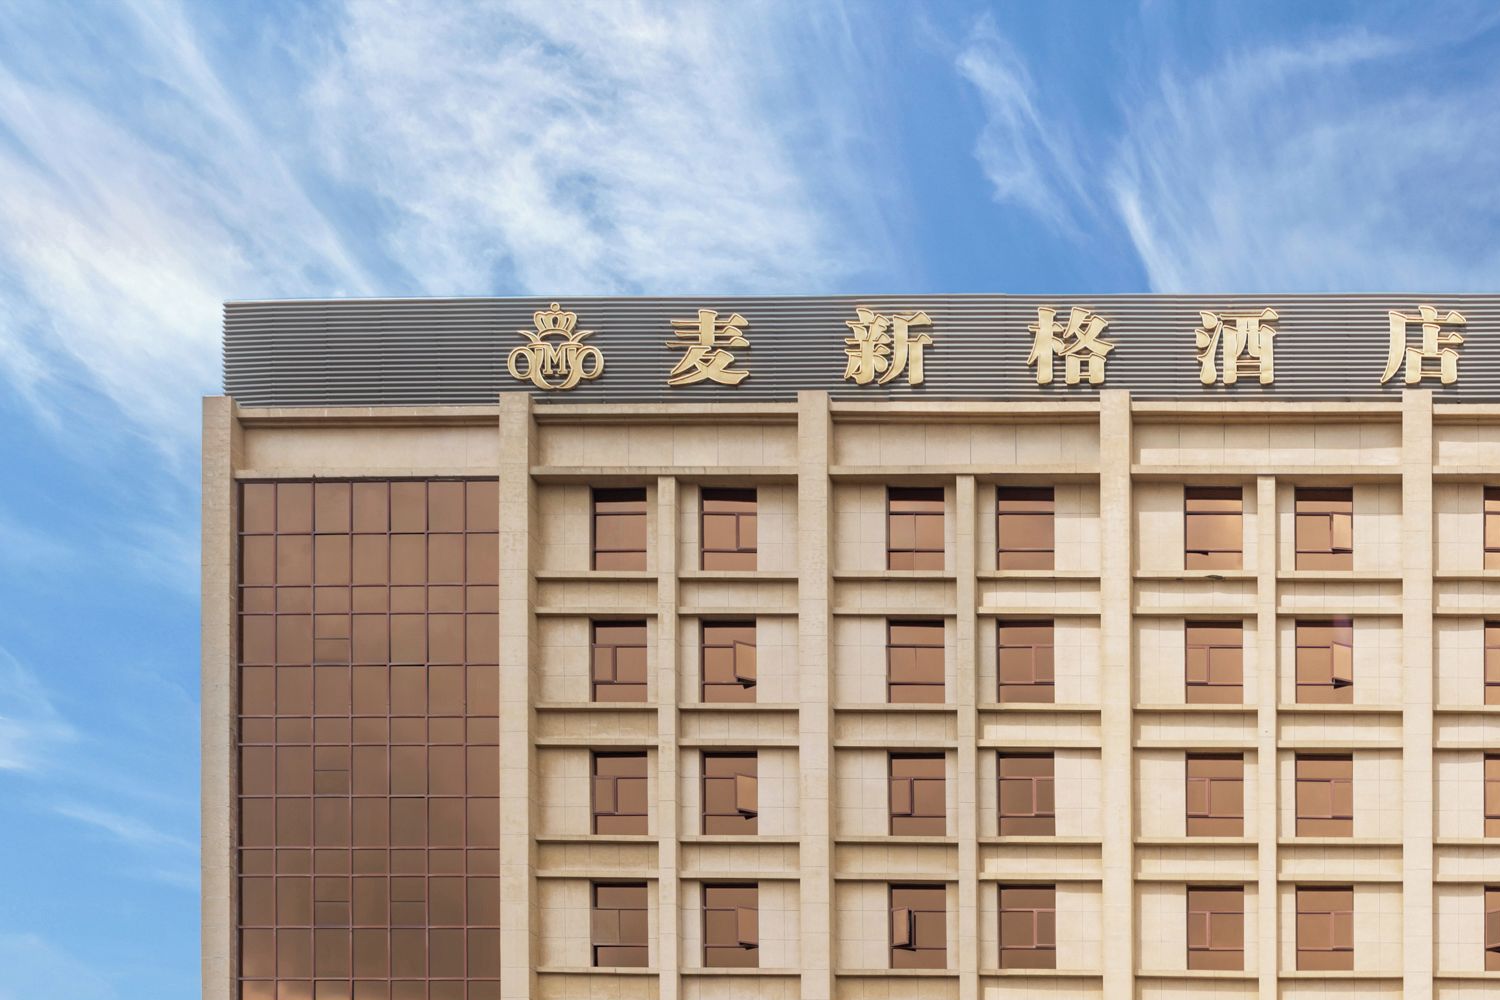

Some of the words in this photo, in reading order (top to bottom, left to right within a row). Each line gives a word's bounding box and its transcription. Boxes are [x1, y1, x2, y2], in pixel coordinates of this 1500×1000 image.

[667, 306, 1467, 386] 麦新格酒店
